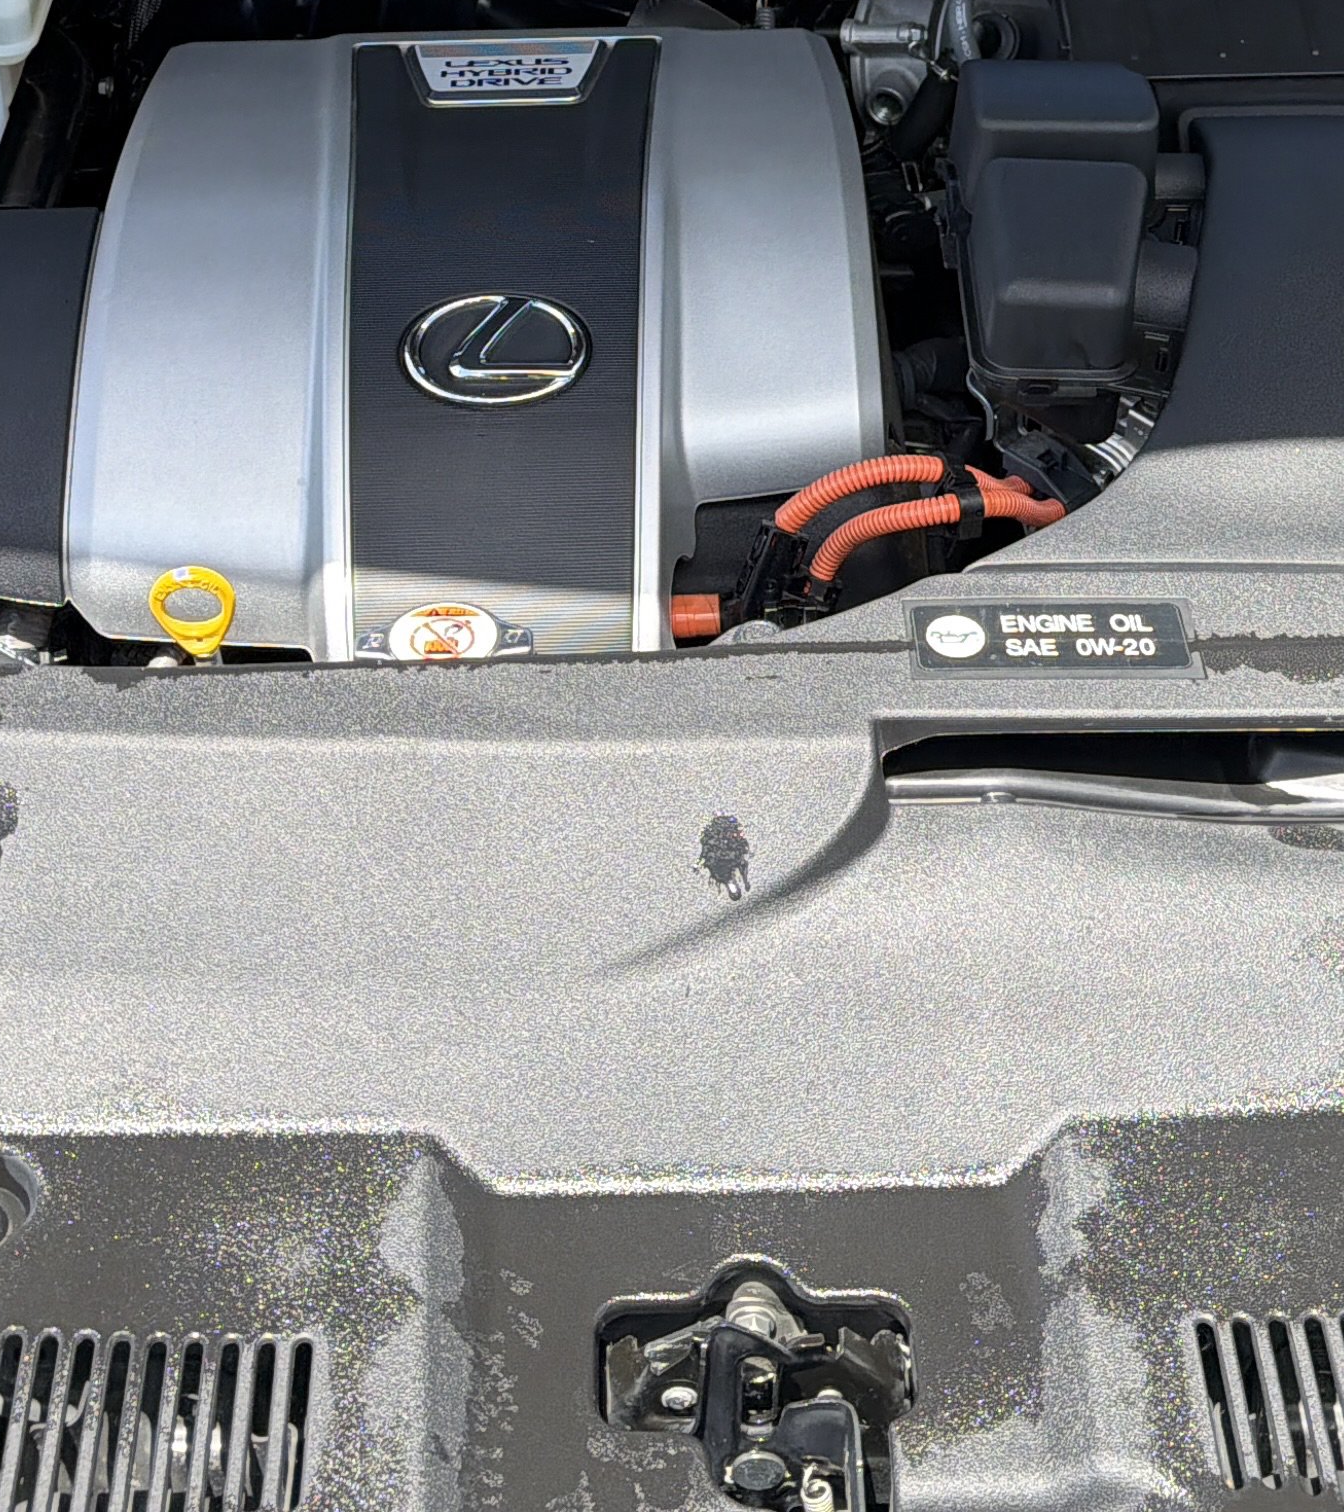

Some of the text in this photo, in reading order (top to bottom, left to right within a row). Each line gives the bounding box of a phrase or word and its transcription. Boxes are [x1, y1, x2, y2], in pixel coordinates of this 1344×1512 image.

[444, 58, 570, 68] LEXUS
[440, 67, 574, 78] HYBRID
[450, 76, 563, 88] DRIVE
[1000, 613, 1154, 633] ENGINE OIL
[1005, 637, 1156, 657] SAE 0W-20
